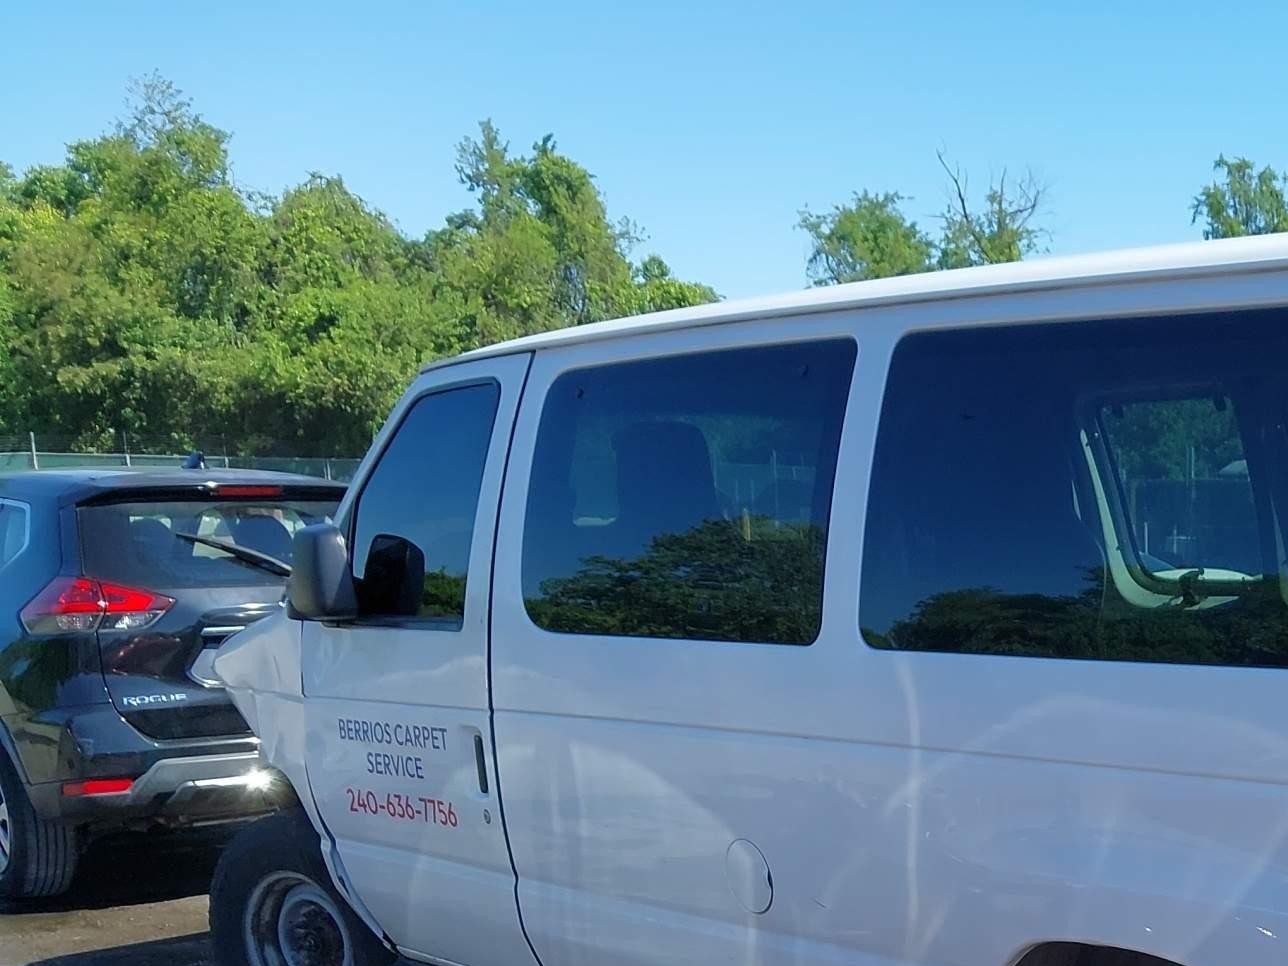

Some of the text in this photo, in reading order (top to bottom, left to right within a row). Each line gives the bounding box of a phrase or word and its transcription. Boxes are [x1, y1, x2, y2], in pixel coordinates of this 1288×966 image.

[122, 693, 187, 706] ROGUE
[338, 718, 447, 751] BERRIOS CARPET
[367, 752, 424, 779] SERVICE
[346, 788, 458, 828] 240-636-7756
